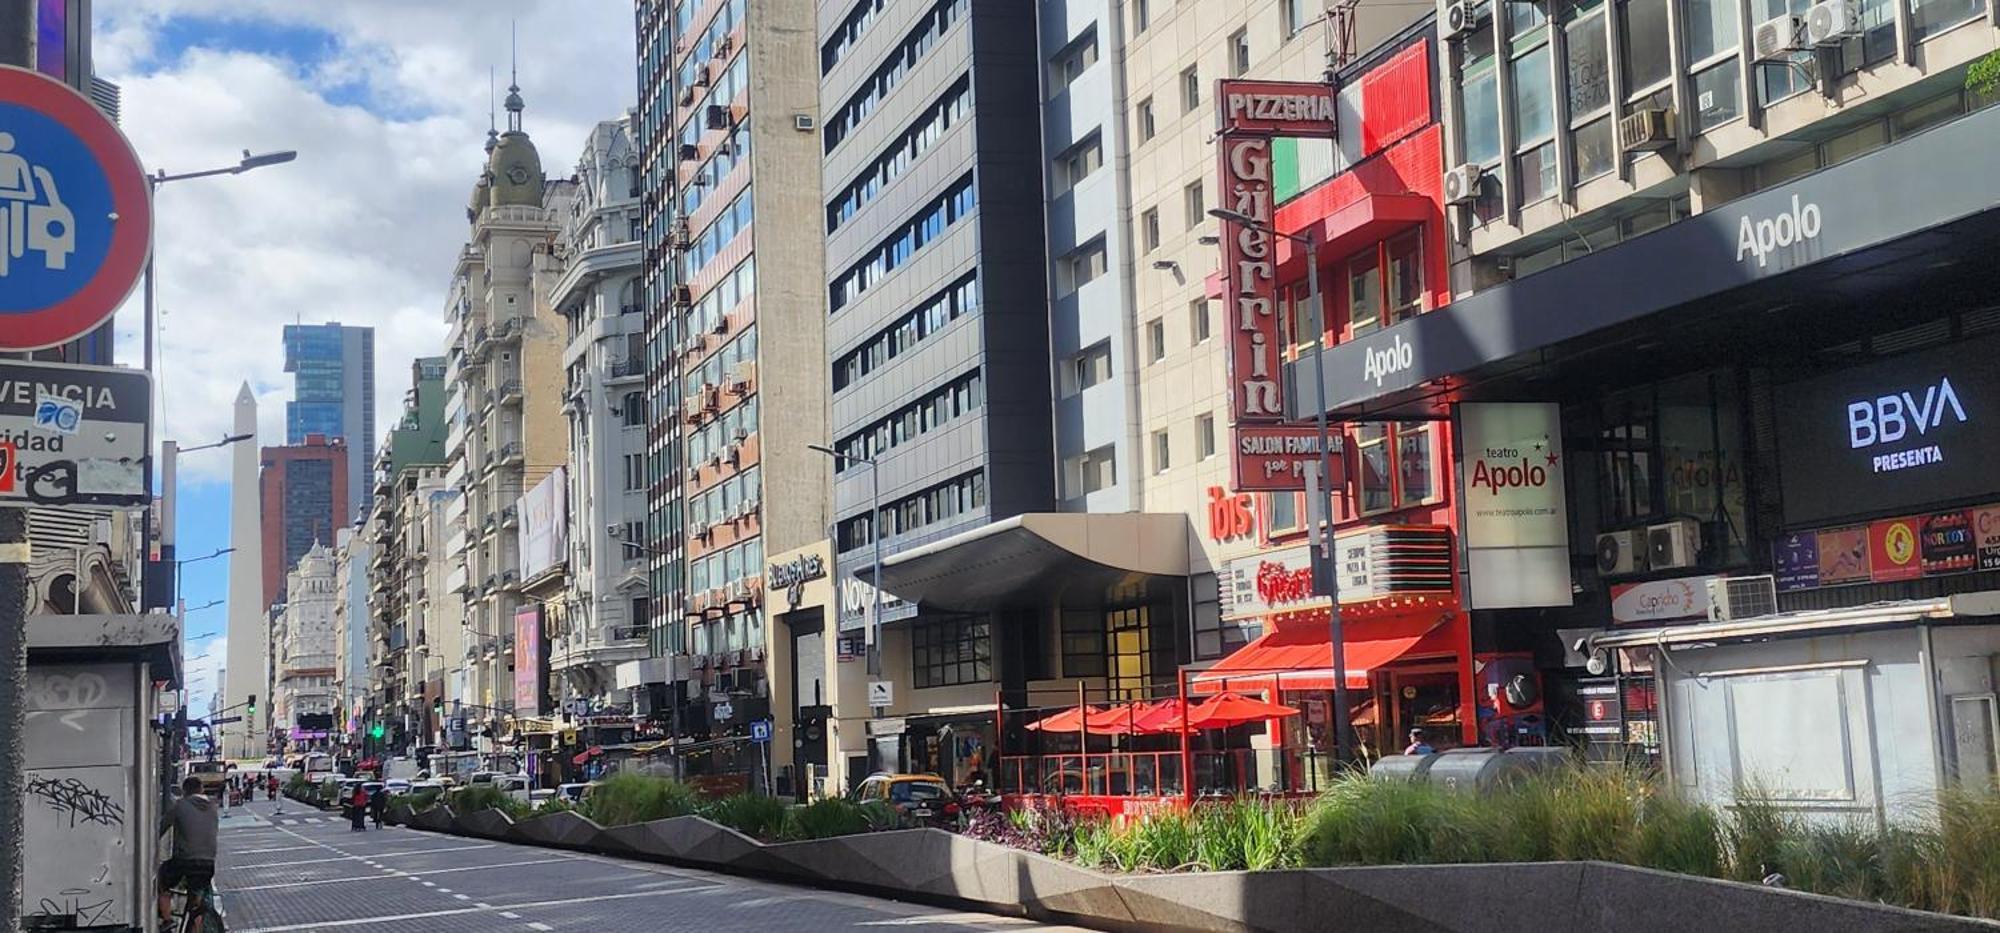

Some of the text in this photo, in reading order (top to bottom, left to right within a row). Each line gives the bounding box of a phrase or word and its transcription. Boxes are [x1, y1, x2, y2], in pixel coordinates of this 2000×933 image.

[1228, 93, 1334, 121] PIZZERIA
[1736, 193, 1821, 268] Apolo
[1364, 334, 1413, 387] Apolo
[1848, 377, 1967, 449] BBVA
[1241, 435, 1343, 454] SALON FAMILAR
[1486, 447, 1519, 458] teatro
[1873, 445, 1943, 473] PRESENTA
[1471, 457, 1546, 496] Apolo
[1208, 486, 1253, 540] ibis
